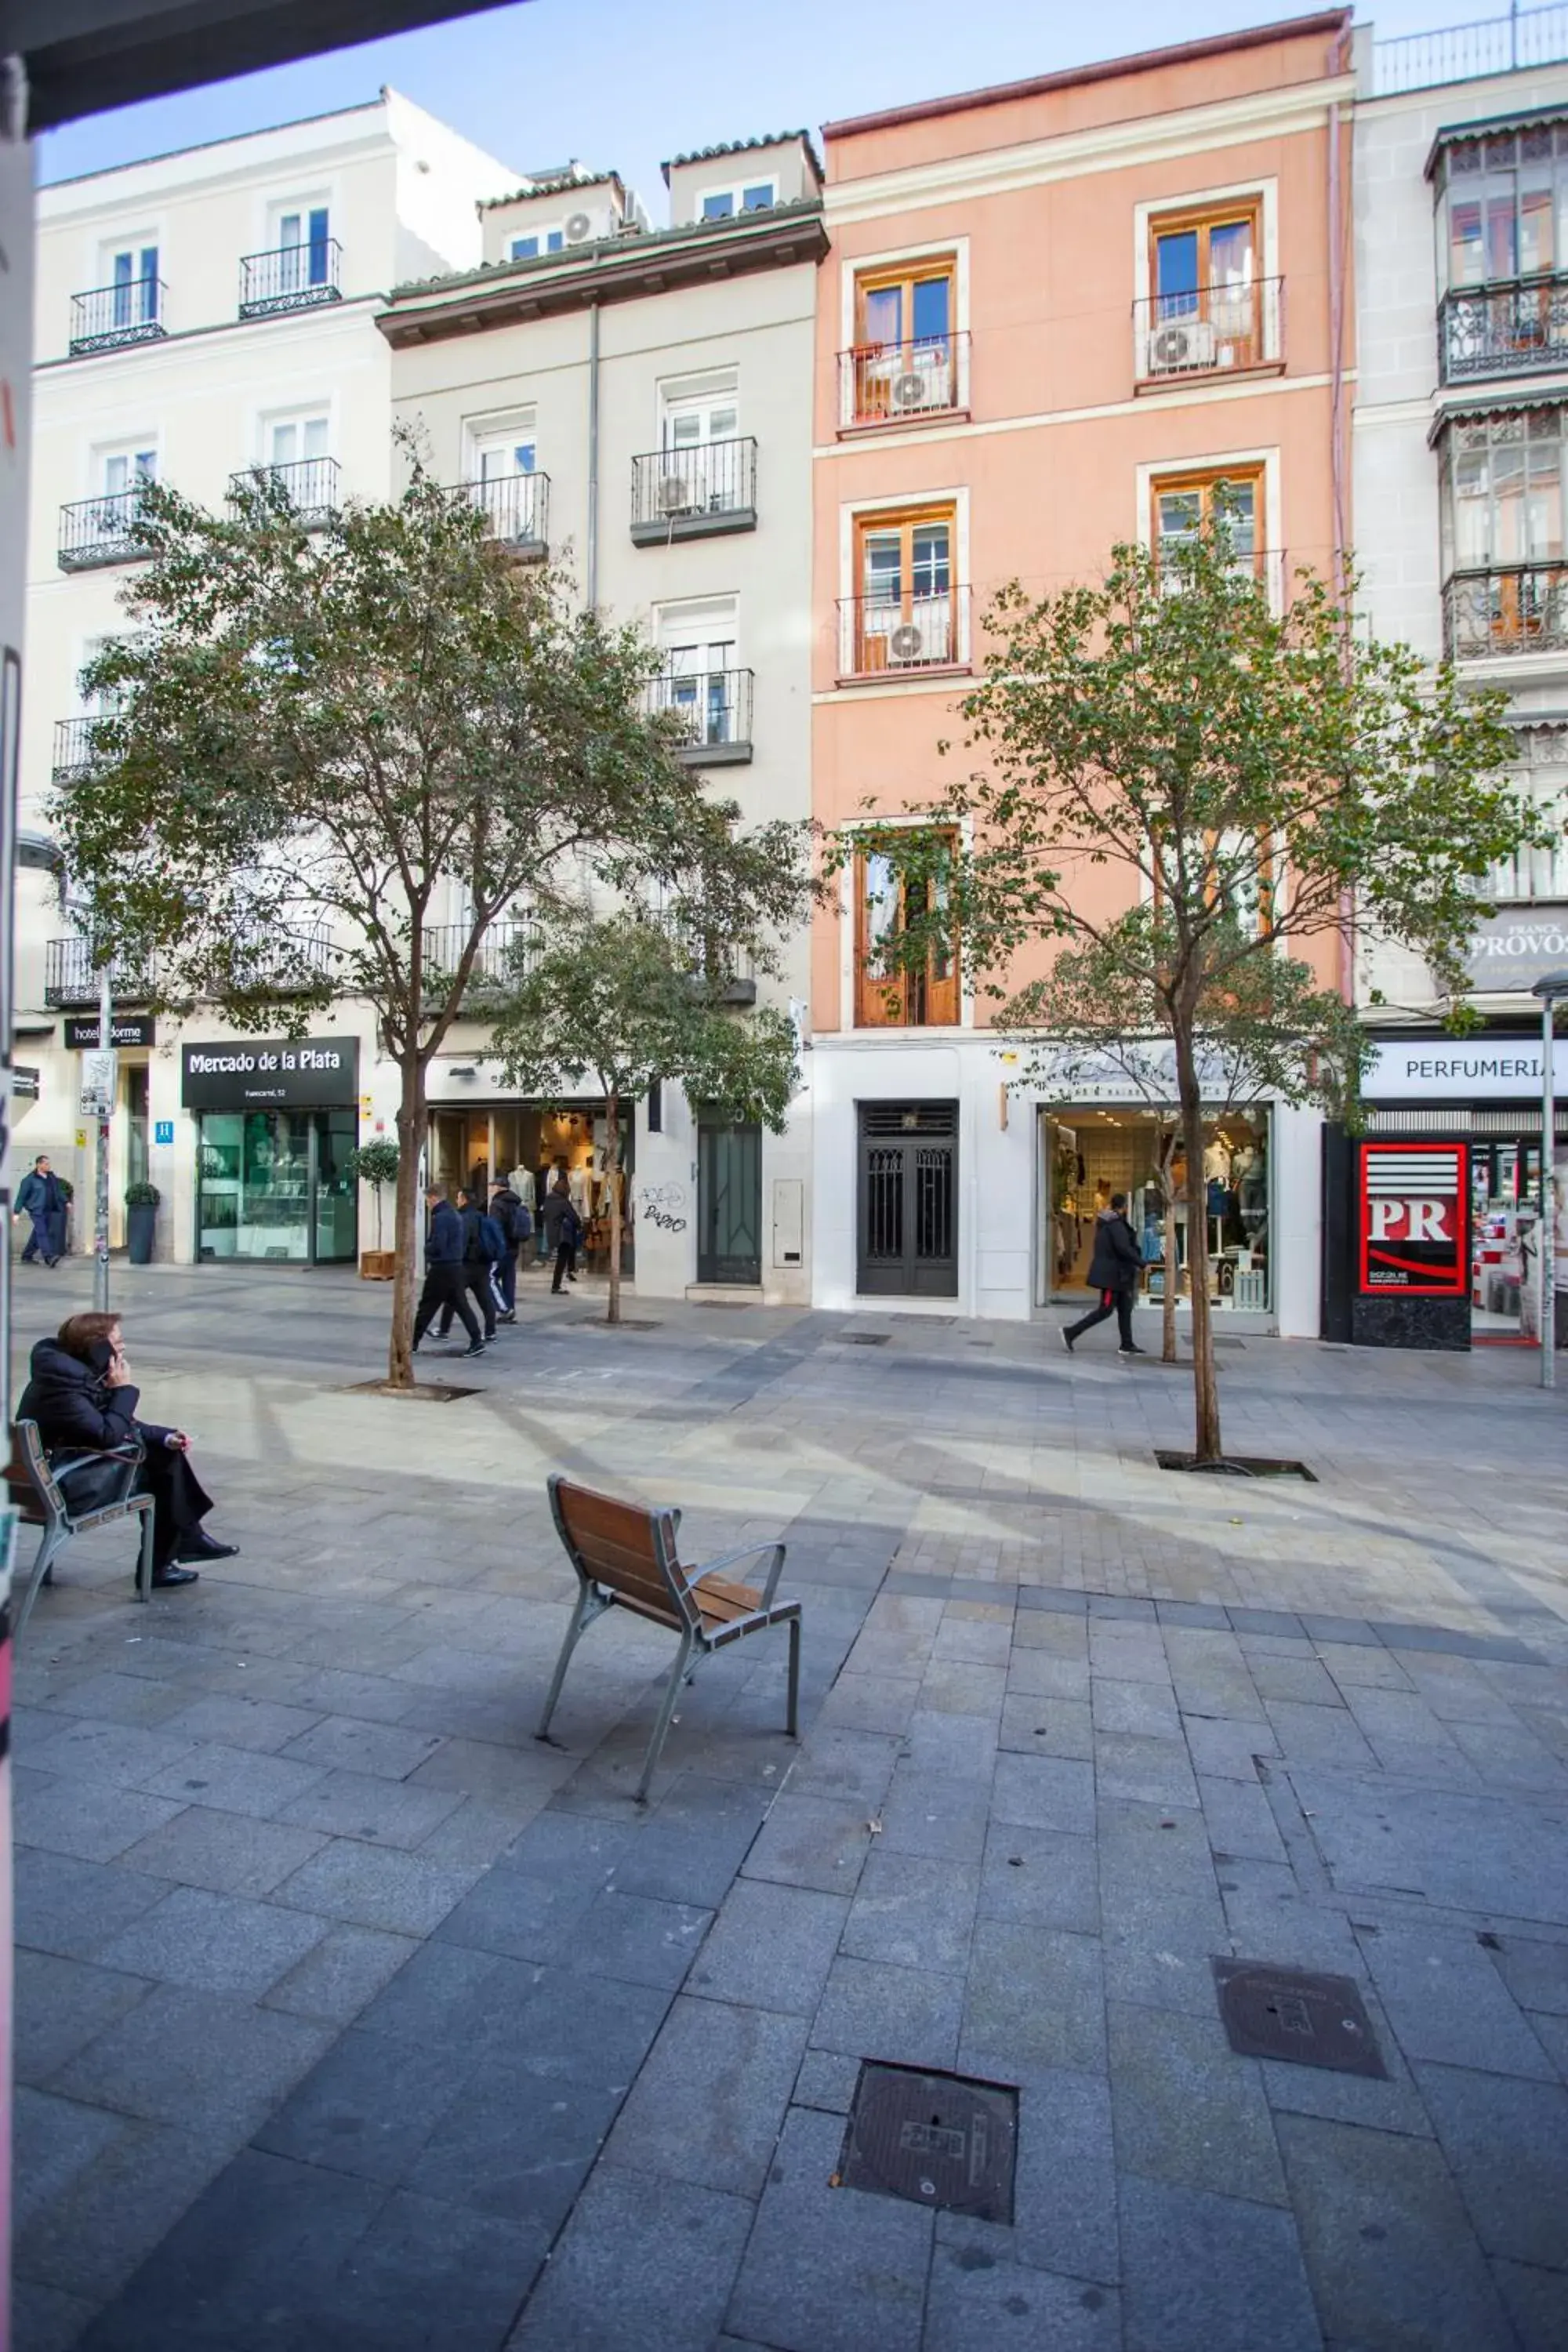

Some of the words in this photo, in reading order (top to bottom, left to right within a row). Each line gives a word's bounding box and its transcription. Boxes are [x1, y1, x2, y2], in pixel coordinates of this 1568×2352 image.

[1472, 934, 1568, 957] PROVO
[74, 1025, 100, 1040] hotel
[190, 1053, 255, 1073] Mercado
[258, 1052, 278, 1070] de
[282, 1051, 295, 1070] la
[299, 1049, 339, 1069] Plata
[1367, 1200, 1453, 1241] PR
